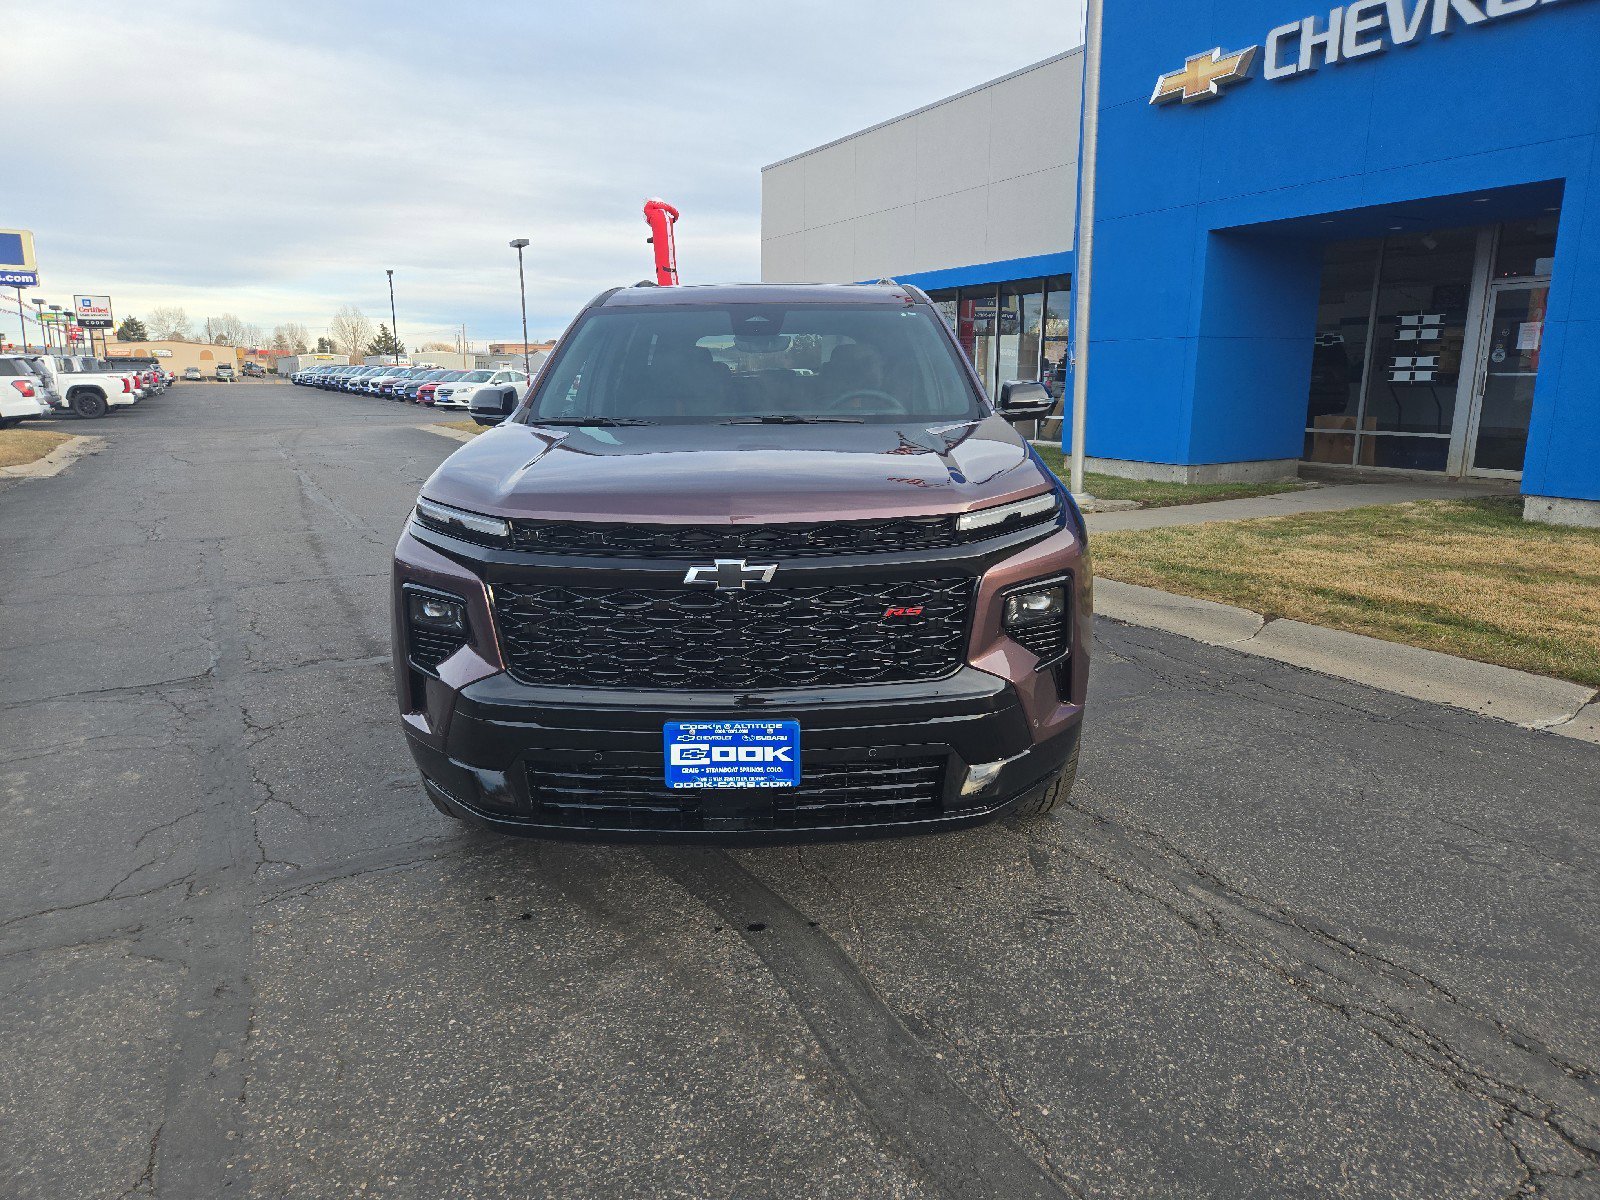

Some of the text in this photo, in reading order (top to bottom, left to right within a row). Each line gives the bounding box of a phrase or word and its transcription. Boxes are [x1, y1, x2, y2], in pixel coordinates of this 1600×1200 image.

[1263, 0, 1558, 81] CHEVR
[883, 606, 925, 617] RS
[670, 743, 794, 766] COOK
